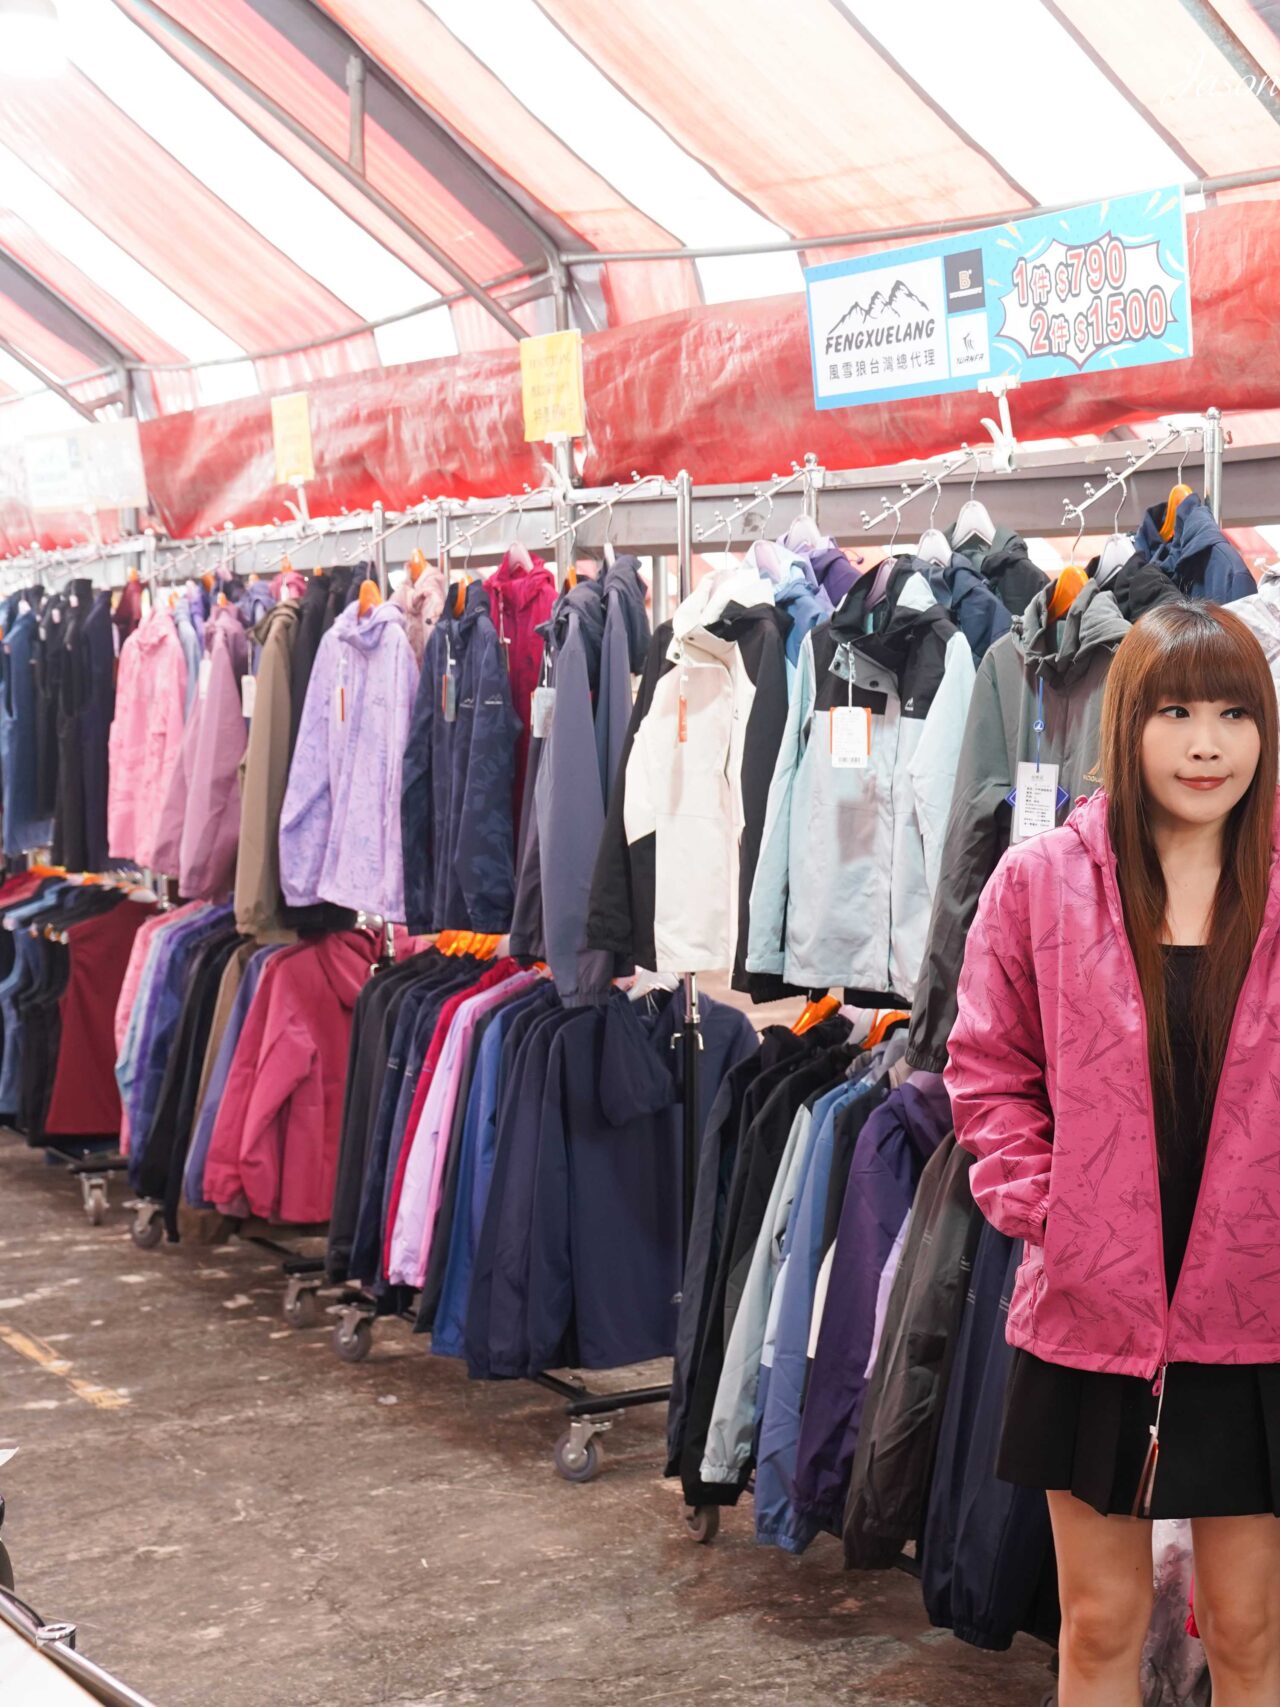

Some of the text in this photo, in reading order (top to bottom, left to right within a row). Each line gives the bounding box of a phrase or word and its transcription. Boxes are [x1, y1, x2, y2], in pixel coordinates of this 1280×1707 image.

[825, 318, 936, 355] FENGXUELANG
[828, 348, 936, 381] 風雪狼台灣總代理
